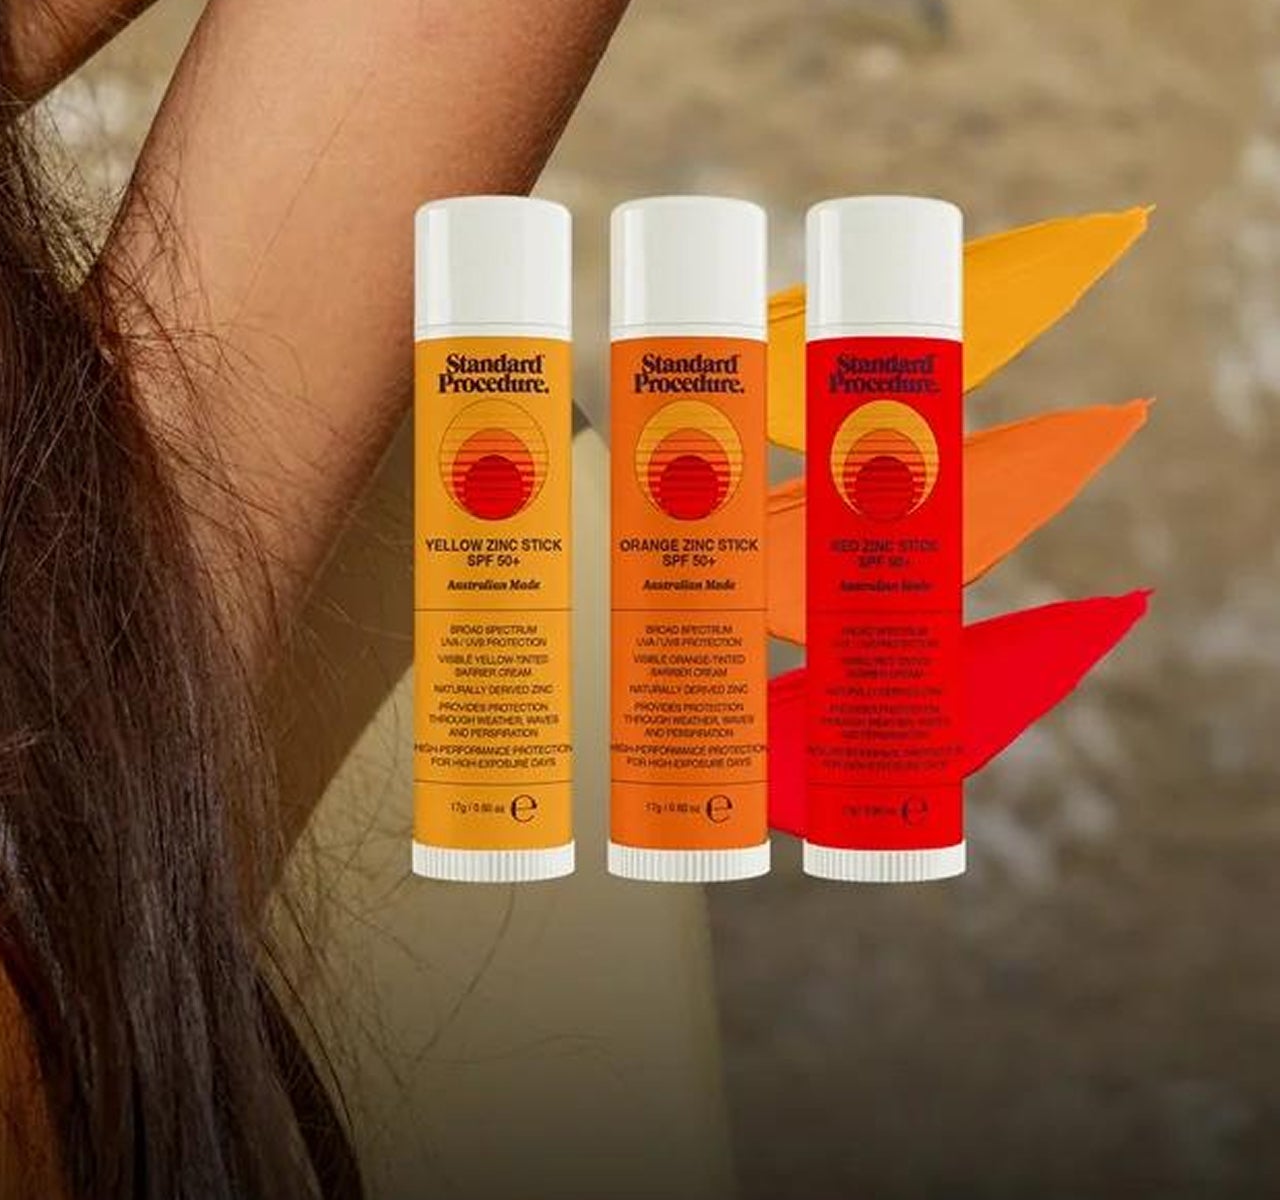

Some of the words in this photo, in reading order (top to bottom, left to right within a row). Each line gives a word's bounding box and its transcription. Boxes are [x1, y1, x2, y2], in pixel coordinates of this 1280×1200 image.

[446, 353, 542, 374] Standard
[641, 353, 737, 374] Standard
[838, 354, 934, 375] Standard
[438, 373, 550, 394] Procedure.
[633, 373, 745, 394] Procedure.
[426, 538, 482, 551] YELLOW
[486, 538, 517, 551] ZINC
[521, 538, 562, 551] STICK
[620, 538, 678, 551] ORANGE
[682, 538, 714, 551] ZINC
[718, 538, 758, 551] STICK
[467, 555, 493, 568] SPF
[497, 555, 520, 568] 50+
[662, 555, 688, 568] SPF
[692, 555, 715, 568] 50+
[447, 579, 507, 590] Australian
[510, 579, 540, 590] Made
[642, 579, 702, 590] Australian
[705, 579, 736, 590] Made
[487, 638, 547, 647] PROTECTION
